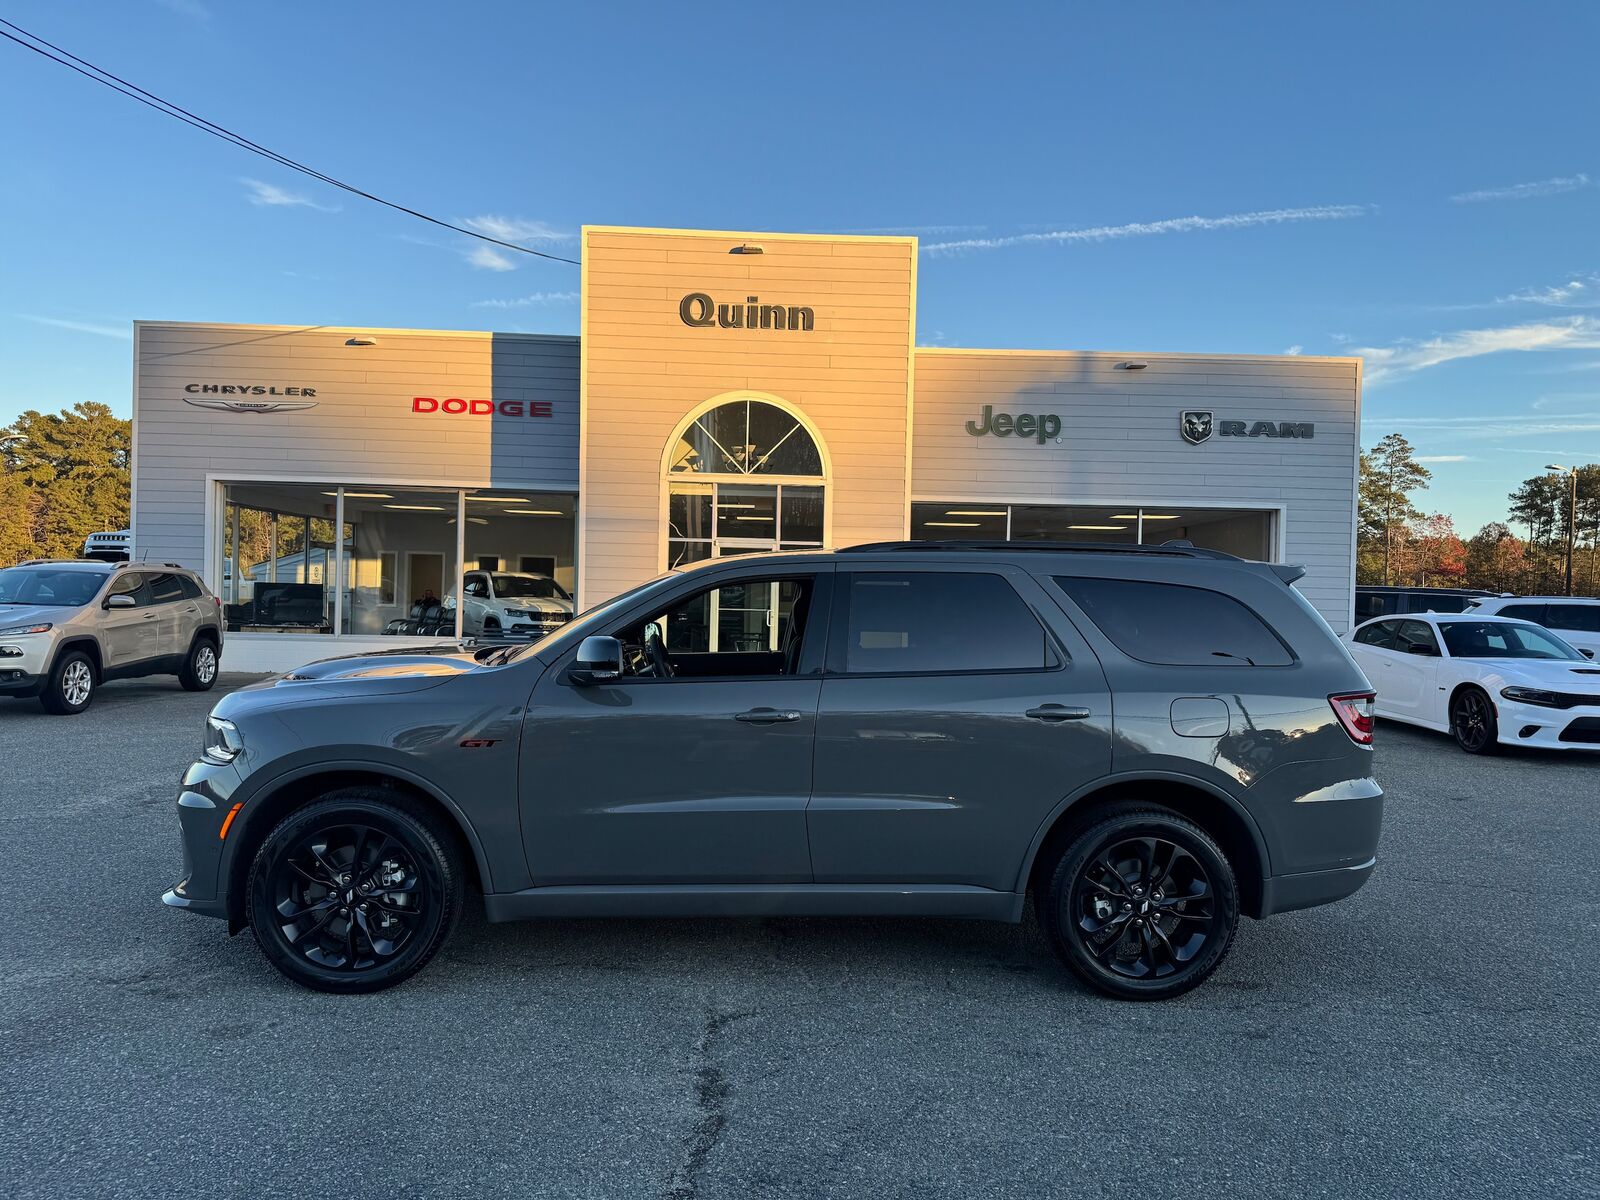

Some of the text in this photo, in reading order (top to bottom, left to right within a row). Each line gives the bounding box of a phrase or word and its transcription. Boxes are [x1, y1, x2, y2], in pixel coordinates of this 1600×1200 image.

[679, 292, 815, 331] Quinn
[184, 383, 317, 397] CHRYSLER
[411, 397, 553, 418] DODGE
[965, 405, 1062, 445] Jeep
[1220, 421, 1315, 439] RAM
[460, 739, 503, 748] GT
